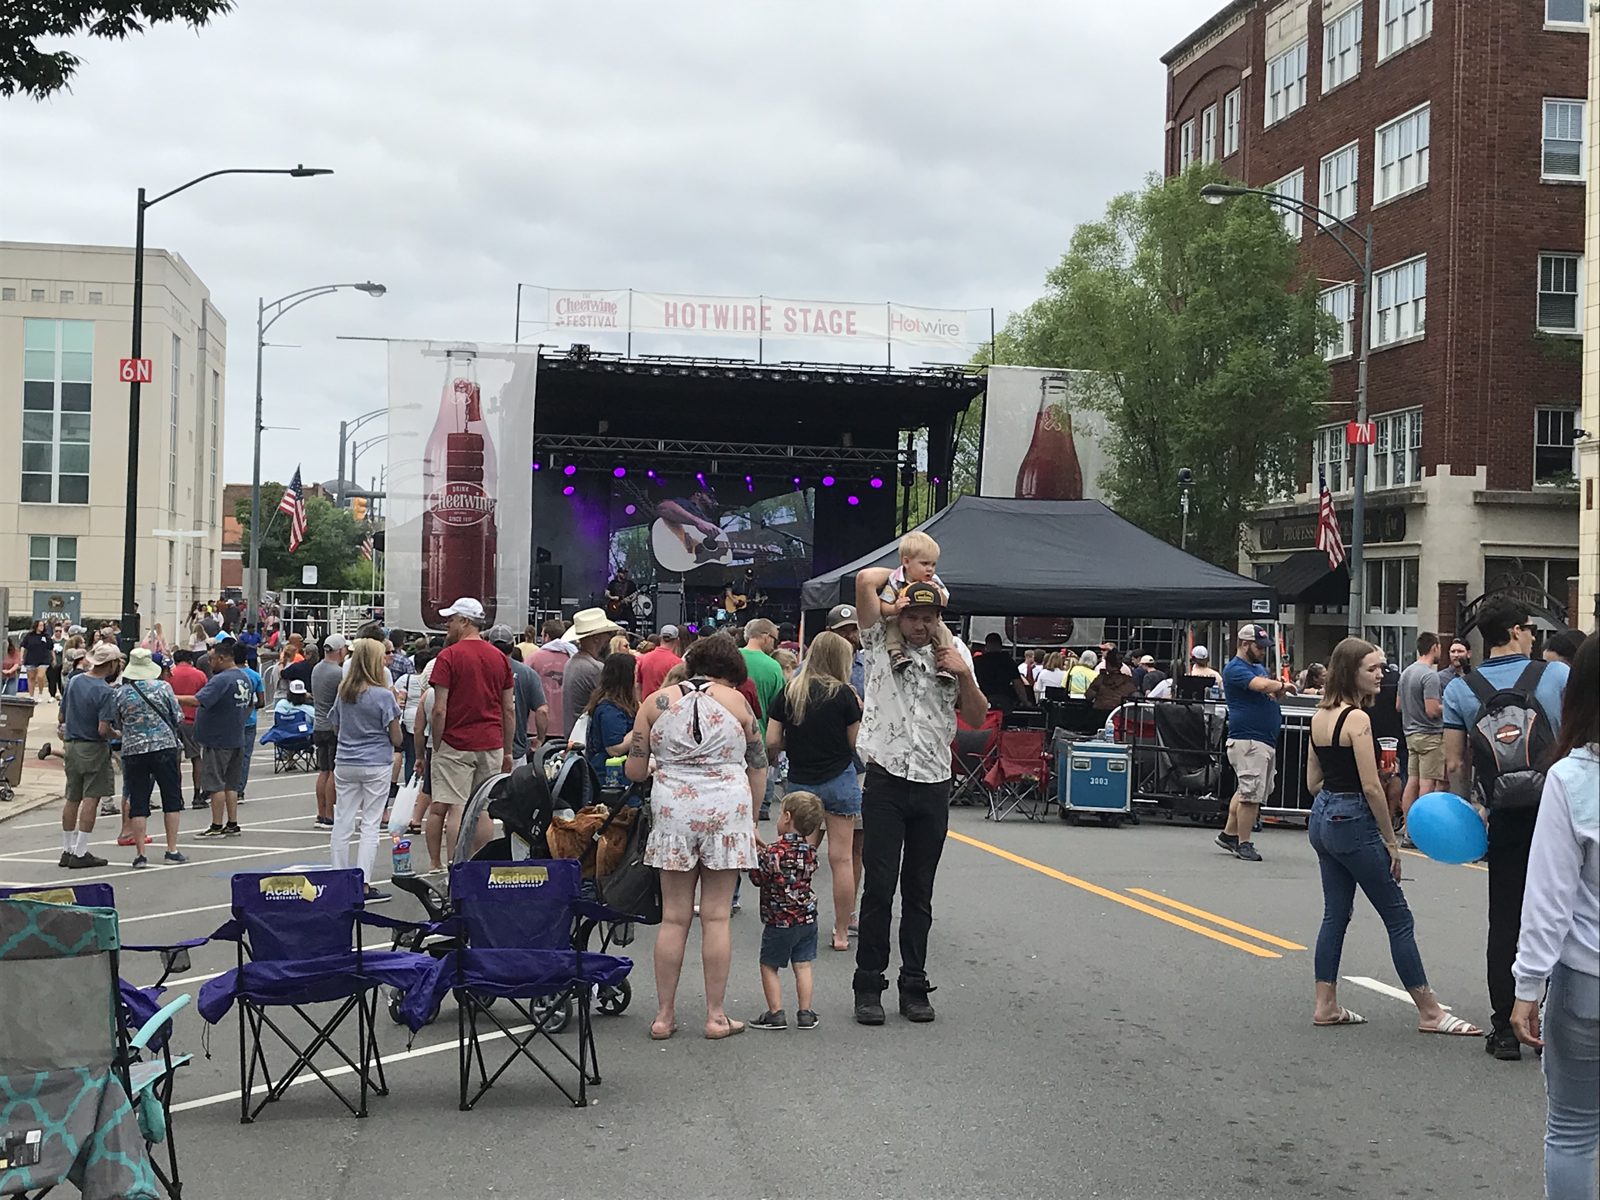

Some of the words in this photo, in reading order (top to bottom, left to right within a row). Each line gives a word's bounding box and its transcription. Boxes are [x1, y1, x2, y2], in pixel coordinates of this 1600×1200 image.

[556, 298, 617, 315] Cheerwine
[567, 315, 617, 328] FESTIVAL
[664, 302, 772, 331] HOTWIRE
[783, 307, 857, 336] STAGE
[891, 313, 960, 336] Hotwire
[122, 360, 149, 380] 6N
[1356, 423, 1370, 442] 7N
[428, 491, 495, 513] Cheerwine
[41, 611, 71, 619] ROWAN
[488, 873, 546, 886] Academy
[265, 884, 324, 897] Acadey
